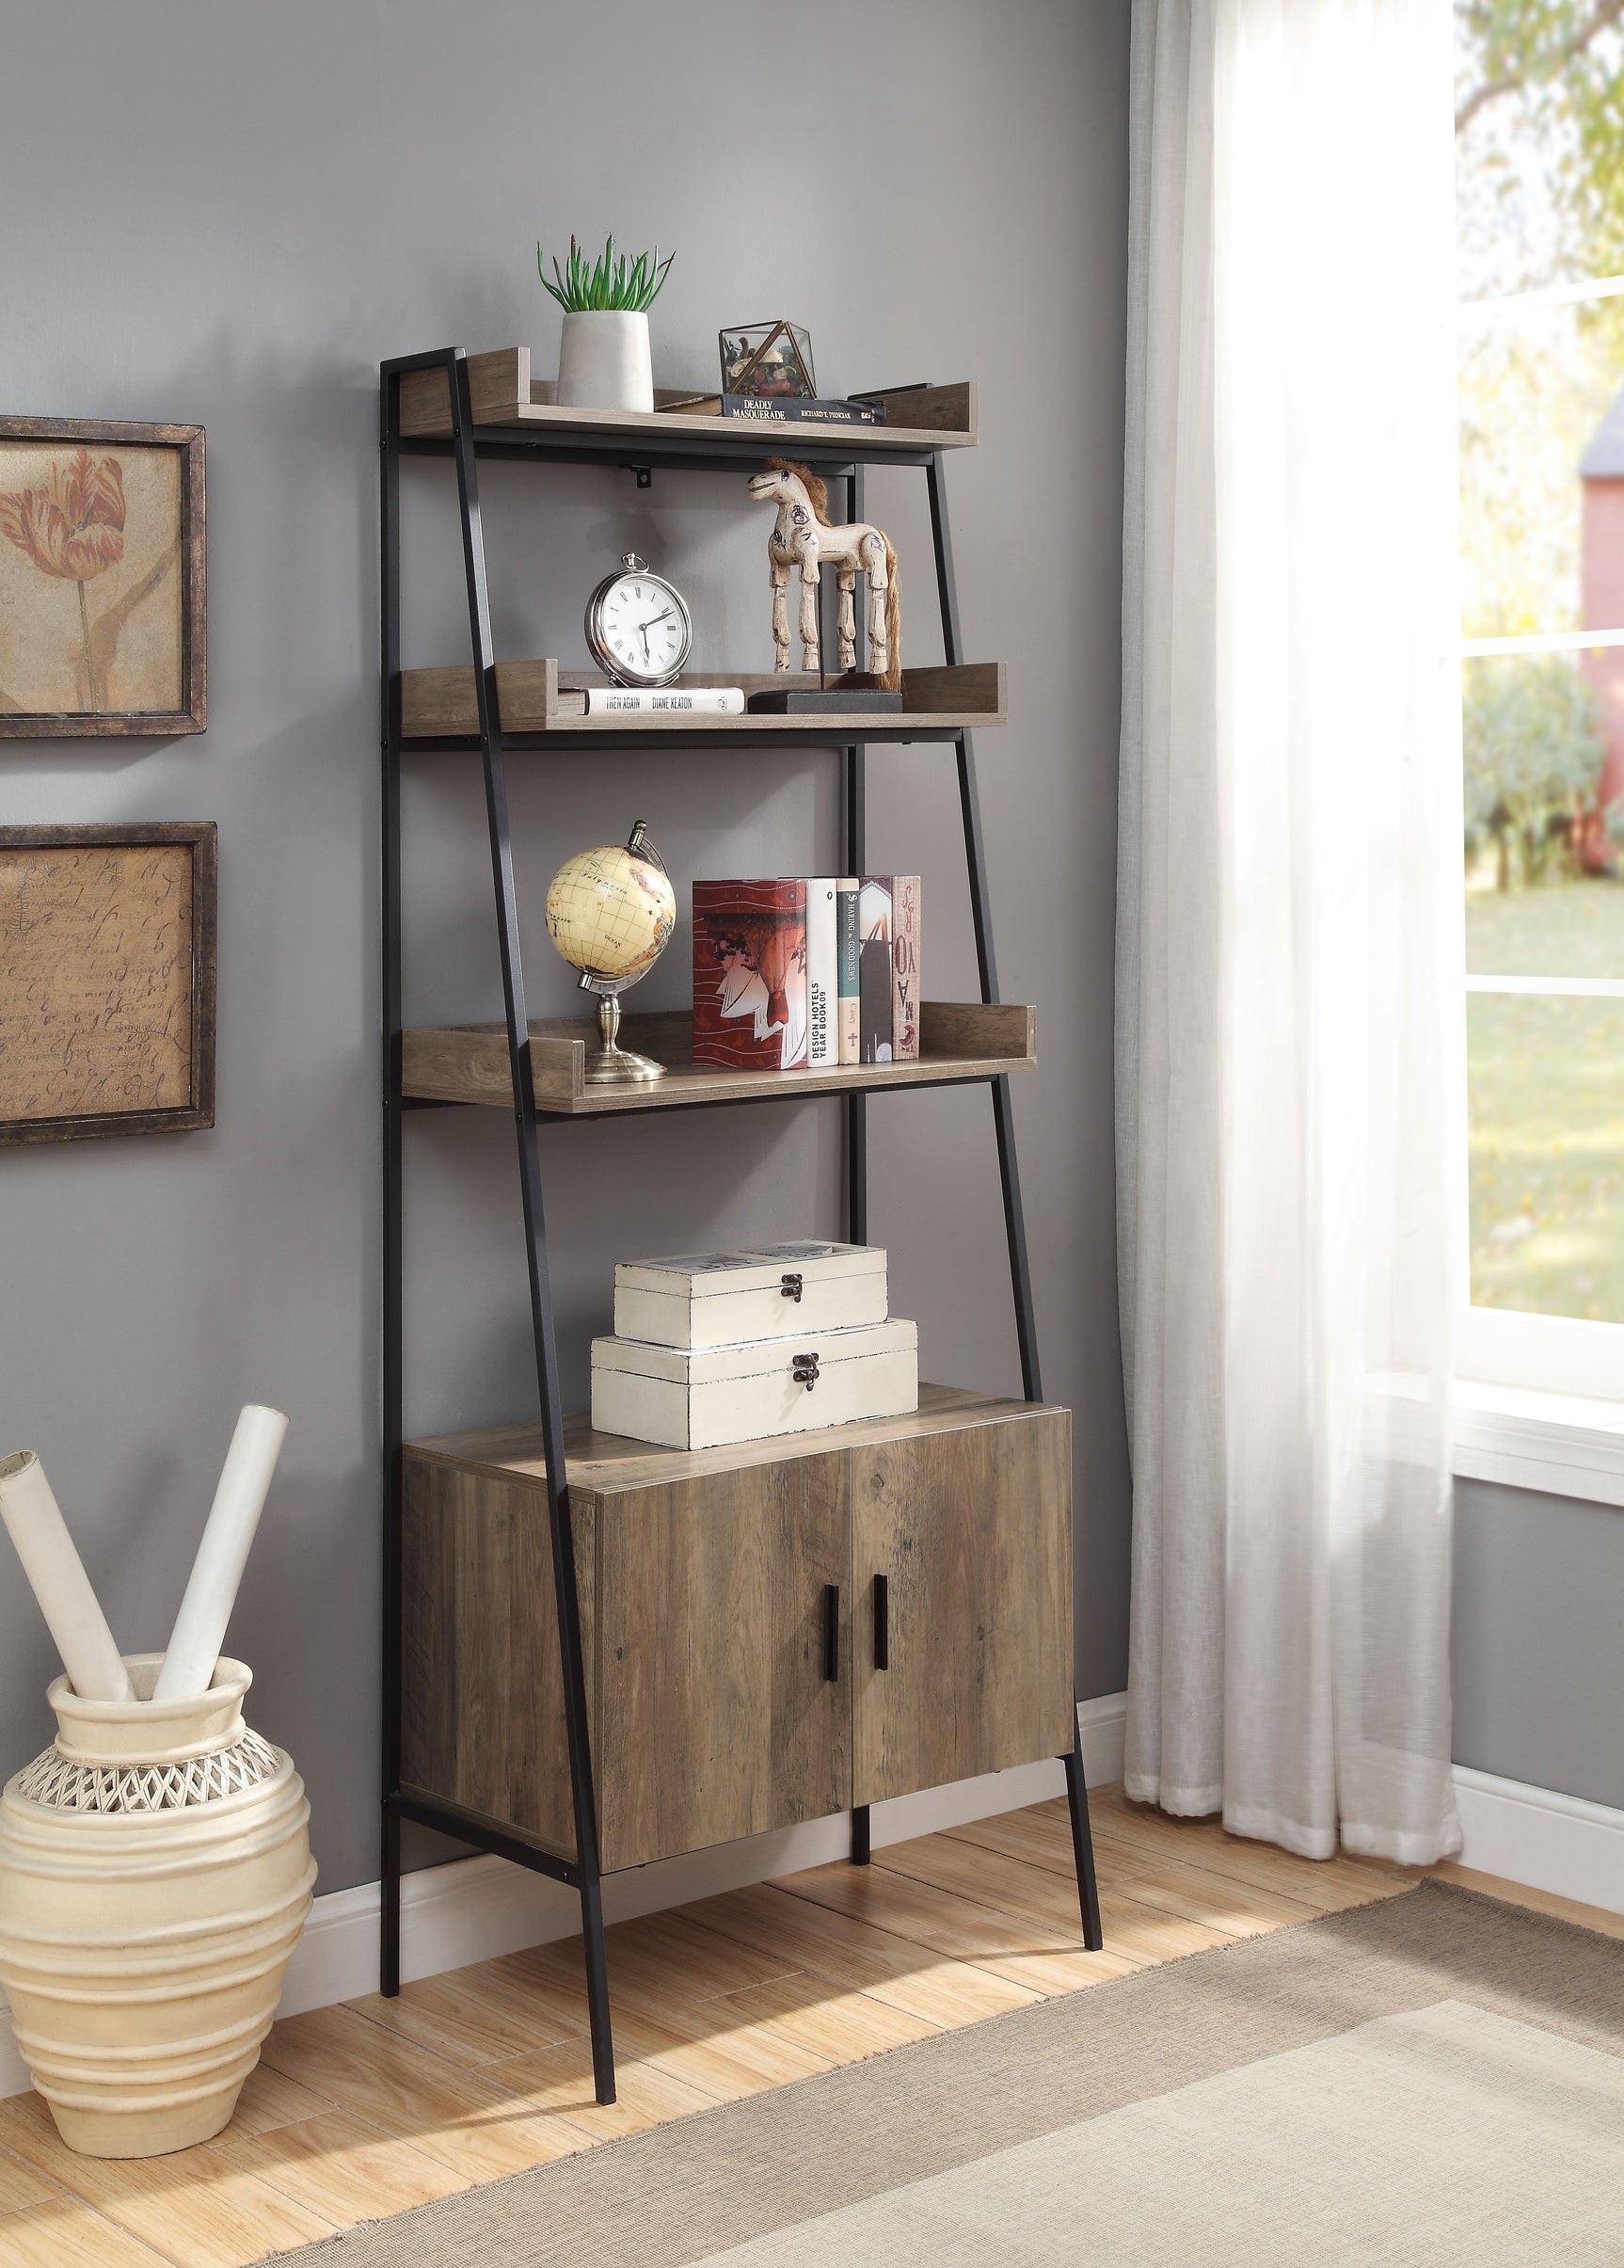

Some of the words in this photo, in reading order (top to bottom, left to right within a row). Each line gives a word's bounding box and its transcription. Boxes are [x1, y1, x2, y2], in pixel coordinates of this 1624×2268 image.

[744, 399, 772, 409] DEADLY
[732, 407, 786, 420] MASQUERADE
[606, 696, 621, 710] THEN
[623, 696, 640, 710] AGAIN
[652, 696, 669, 710] DIANE
[671, 696, 693, 710] KEATON
